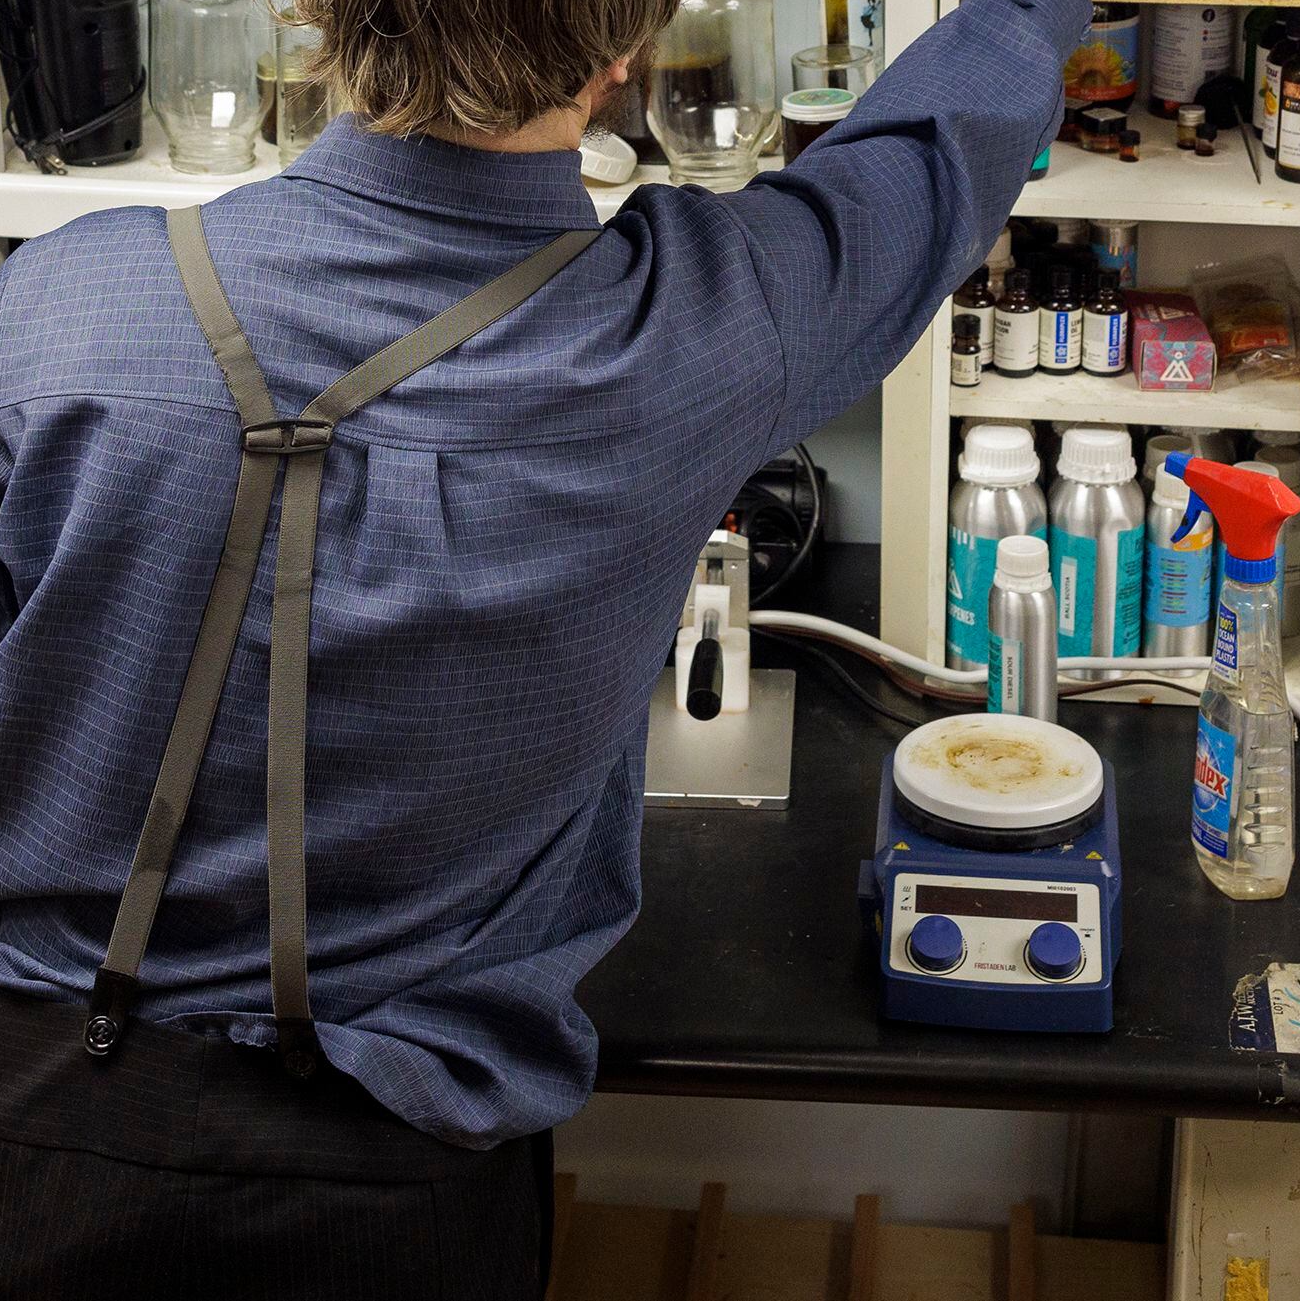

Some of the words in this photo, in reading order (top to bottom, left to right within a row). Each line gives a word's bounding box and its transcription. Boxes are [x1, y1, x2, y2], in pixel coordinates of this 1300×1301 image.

[1219, 618, 1234, 631] 100%
[1218, 628, 1235, 642] OCEAN
[1217, 638, 1234, 653] BOUND
[1215, 649, 1235, 666] PLASTIC
[973, 962, 1005, 971] FRISTADEN
[1005, 964, 1017, 972] LAB
